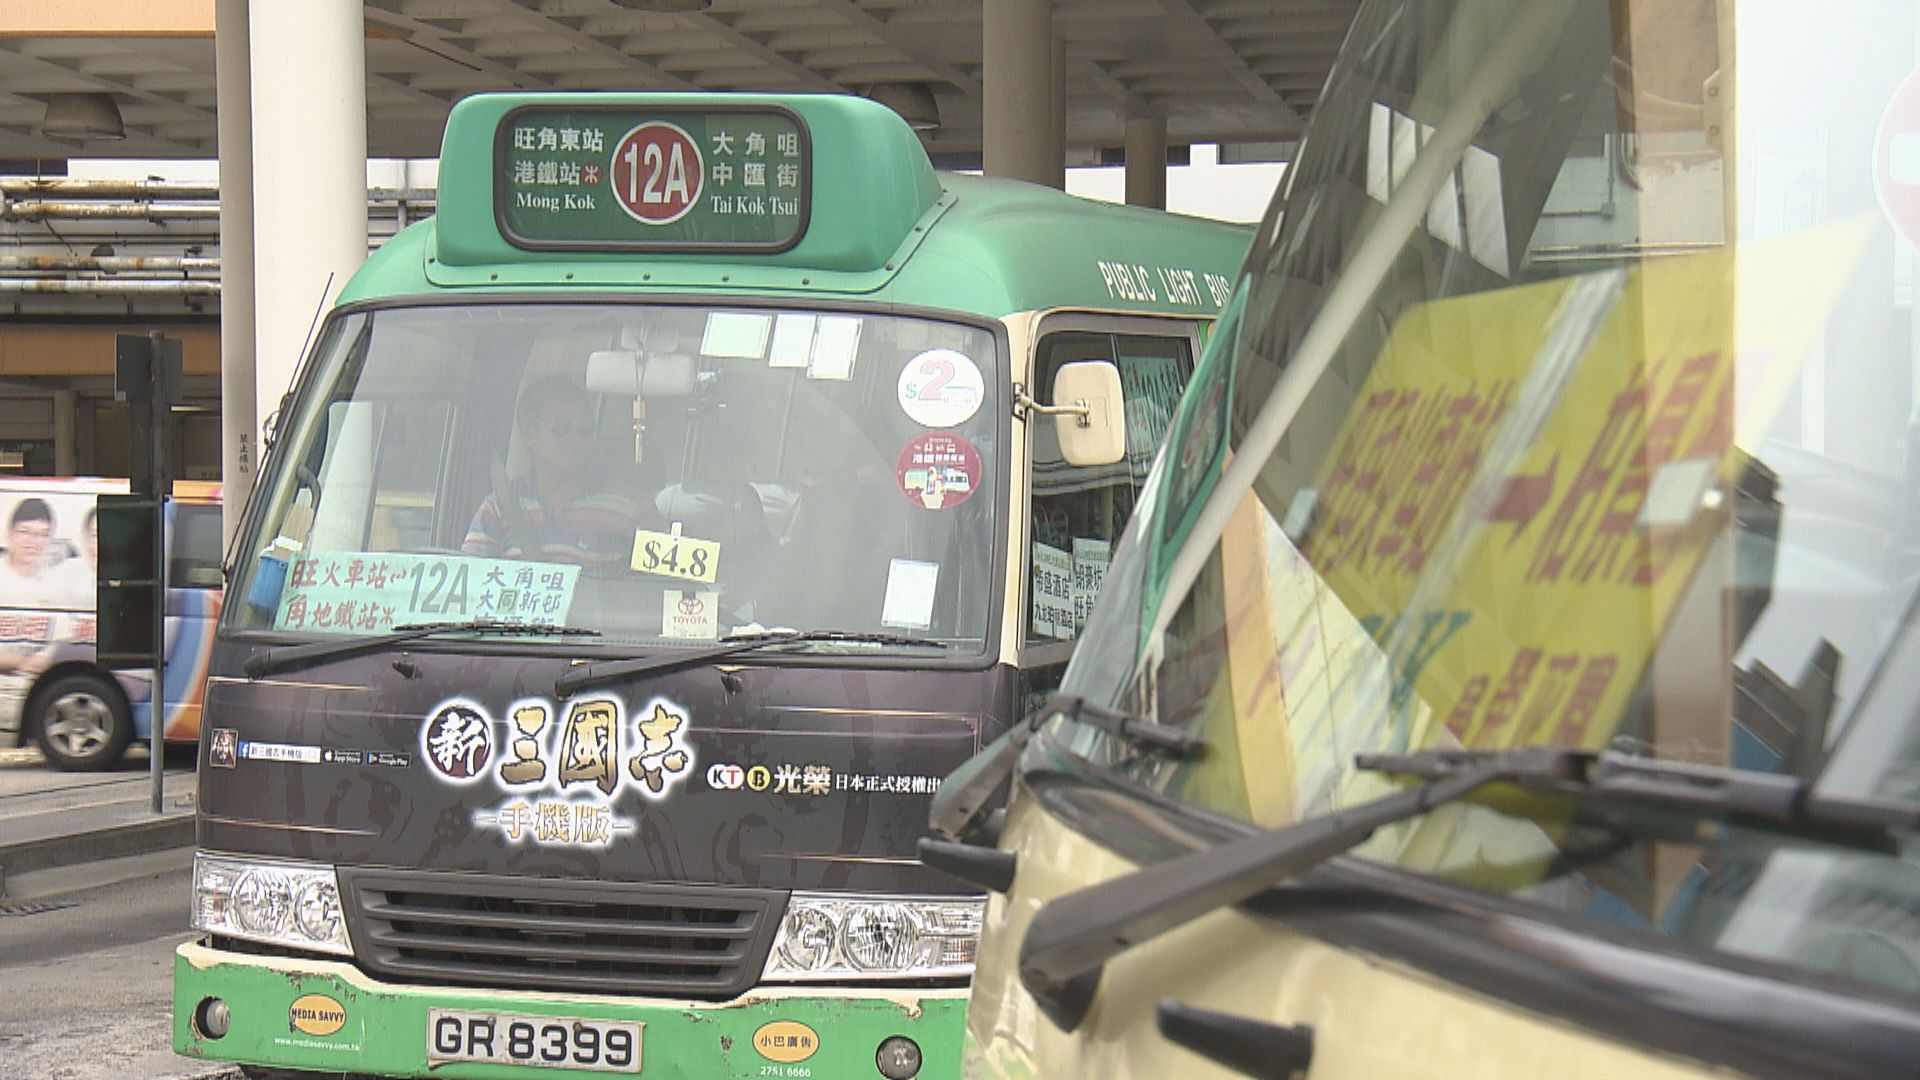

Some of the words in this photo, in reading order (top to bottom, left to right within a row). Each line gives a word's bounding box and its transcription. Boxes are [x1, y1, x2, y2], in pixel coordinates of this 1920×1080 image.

[514, 127, 604, 152] 旺角東站
[712, 131, 799, 158] 大角咀
[514, 159, 581, 185] 港鐵站
[624, 142, 690, 204] 12A
[712, 162, 799, 187] 中匯街
[516, 192, 560, 213] Mong
[564, 193, 596, 211] Kok
[711, 195, 732, 215] Tai
[736, 198, 765, 216] Kok
[769, 197, 799, 216] Tsui
[1097, 260, 1157, 302] PUBLIC
[1156, 266, 1203, 305] LIGHT
[642, 540, 708, 577] $4.8
[408, 561, 470, 615] 12A
[672, 615, 708, 625] TOYOTA
[428, 700, 690, 796] 新三國志
[500, 801, 610, 843] 手機版
[292, 1007, 317, 1020] MEDIA
[319, 1010, 345, 1024] SAVVY
[434, 1016, 496, 1057] GR
[508, 1021, 633, 1067] 8399
[760, 1065, 784, 1077] 2751
[786, 1066, 812, 1078] 6666
